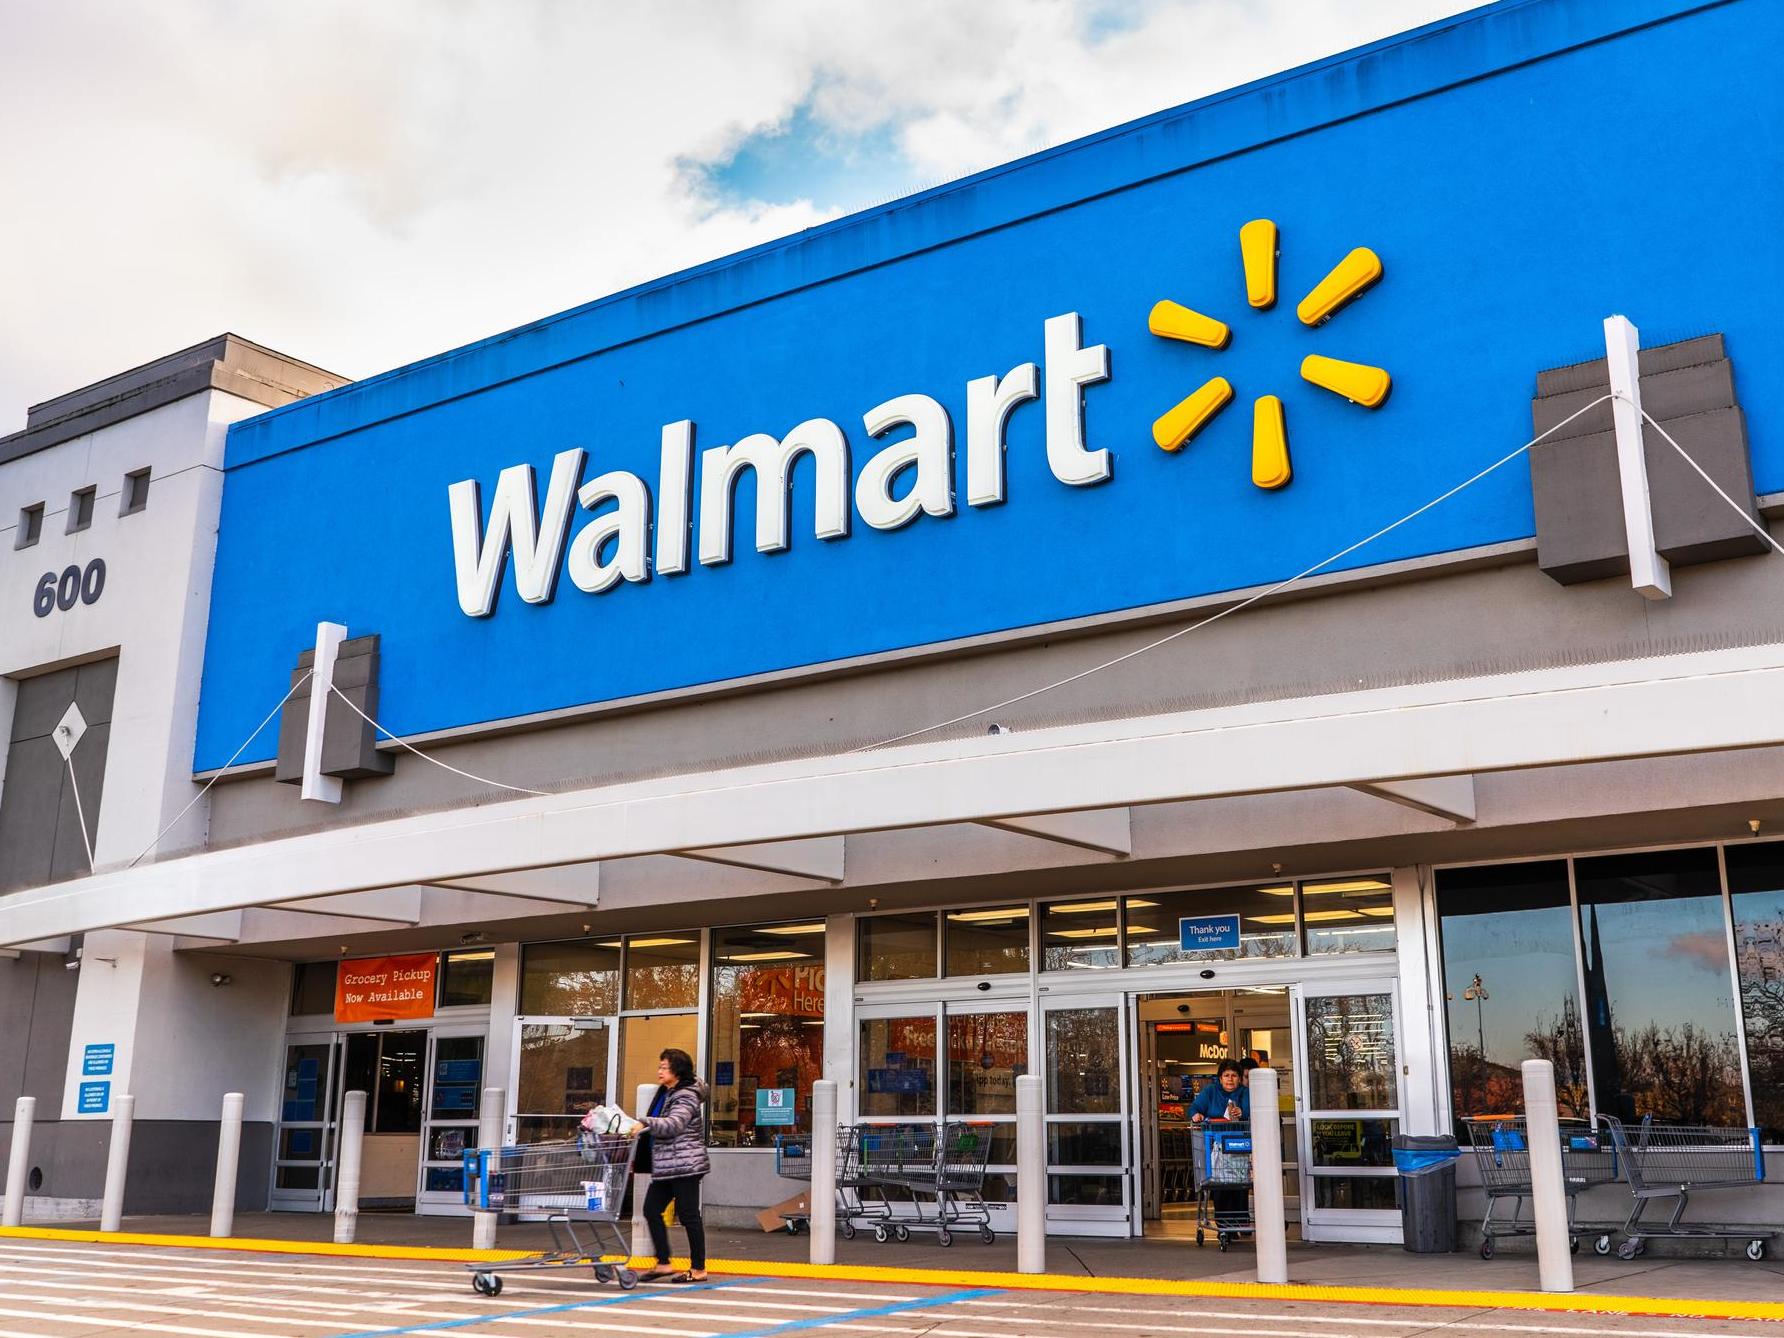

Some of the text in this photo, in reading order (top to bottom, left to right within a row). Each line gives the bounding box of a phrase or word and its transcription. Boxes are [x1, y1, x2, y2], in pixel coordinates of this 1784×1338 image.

[448, 311, 1112, 618] Walmart
[33, 557, 107, 618] 600
[1189, 924, 1231, 936] Thank you
[344, 968, 431, 986] Grocery Pickup
[345, 988, 424, 1004] Now Available
[794, 991, 824, 1013] Here
